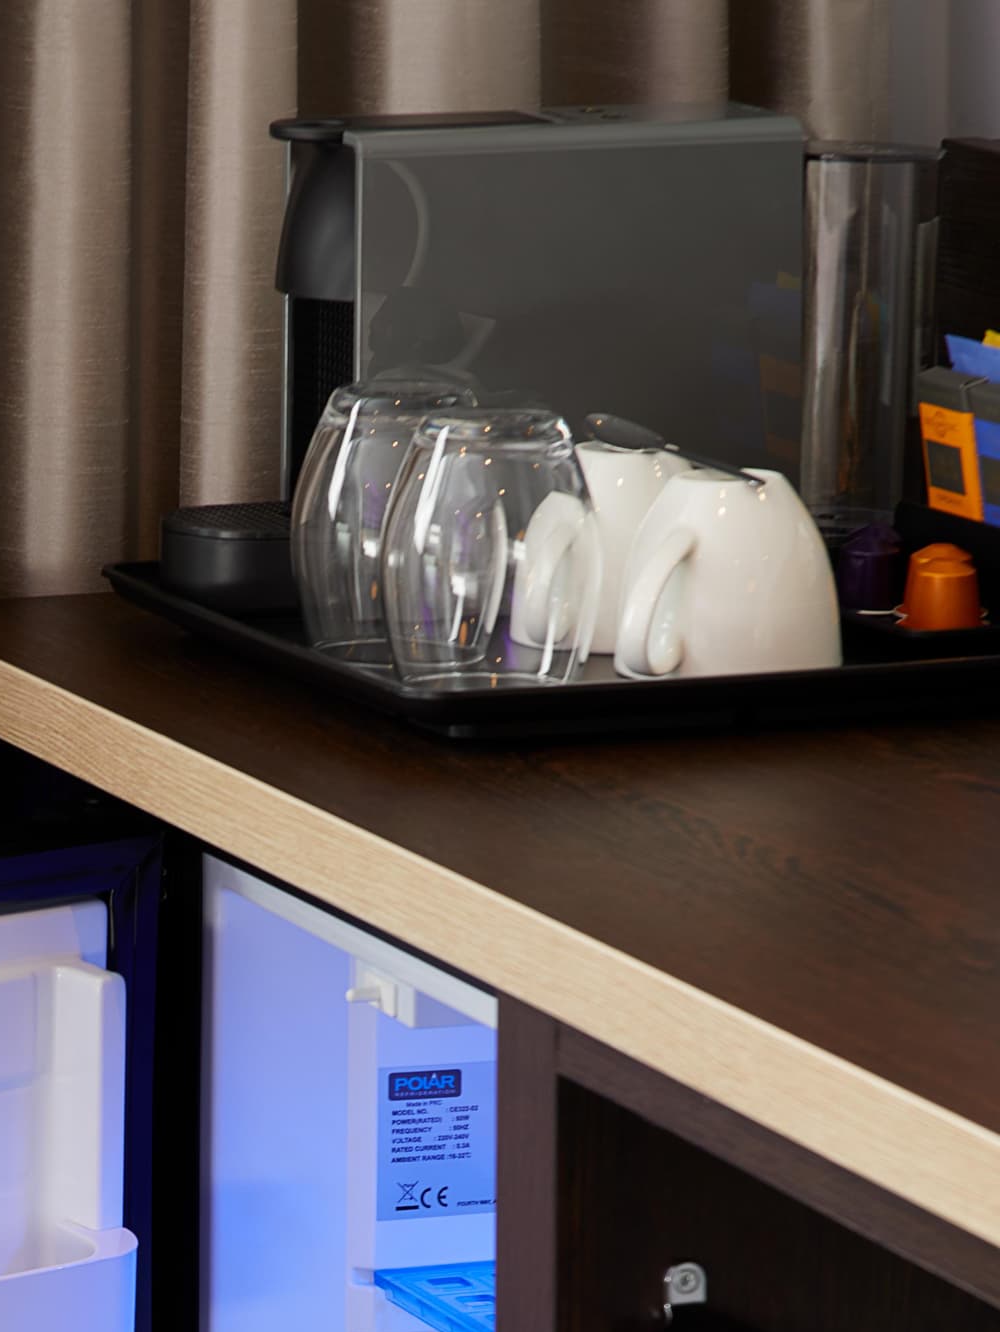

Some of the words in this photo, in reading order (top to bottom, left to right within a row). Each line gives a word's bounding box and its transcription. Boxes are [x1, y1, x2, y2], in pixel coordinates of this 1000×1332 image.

[394, 1073, 456, 1091] POLAR
[391, 1126, 432, 1134] FREQUENCY
[391, 1136, 422, 1144] VOLTAGE
[391, 1155, 421, 1163] AMBIENT
